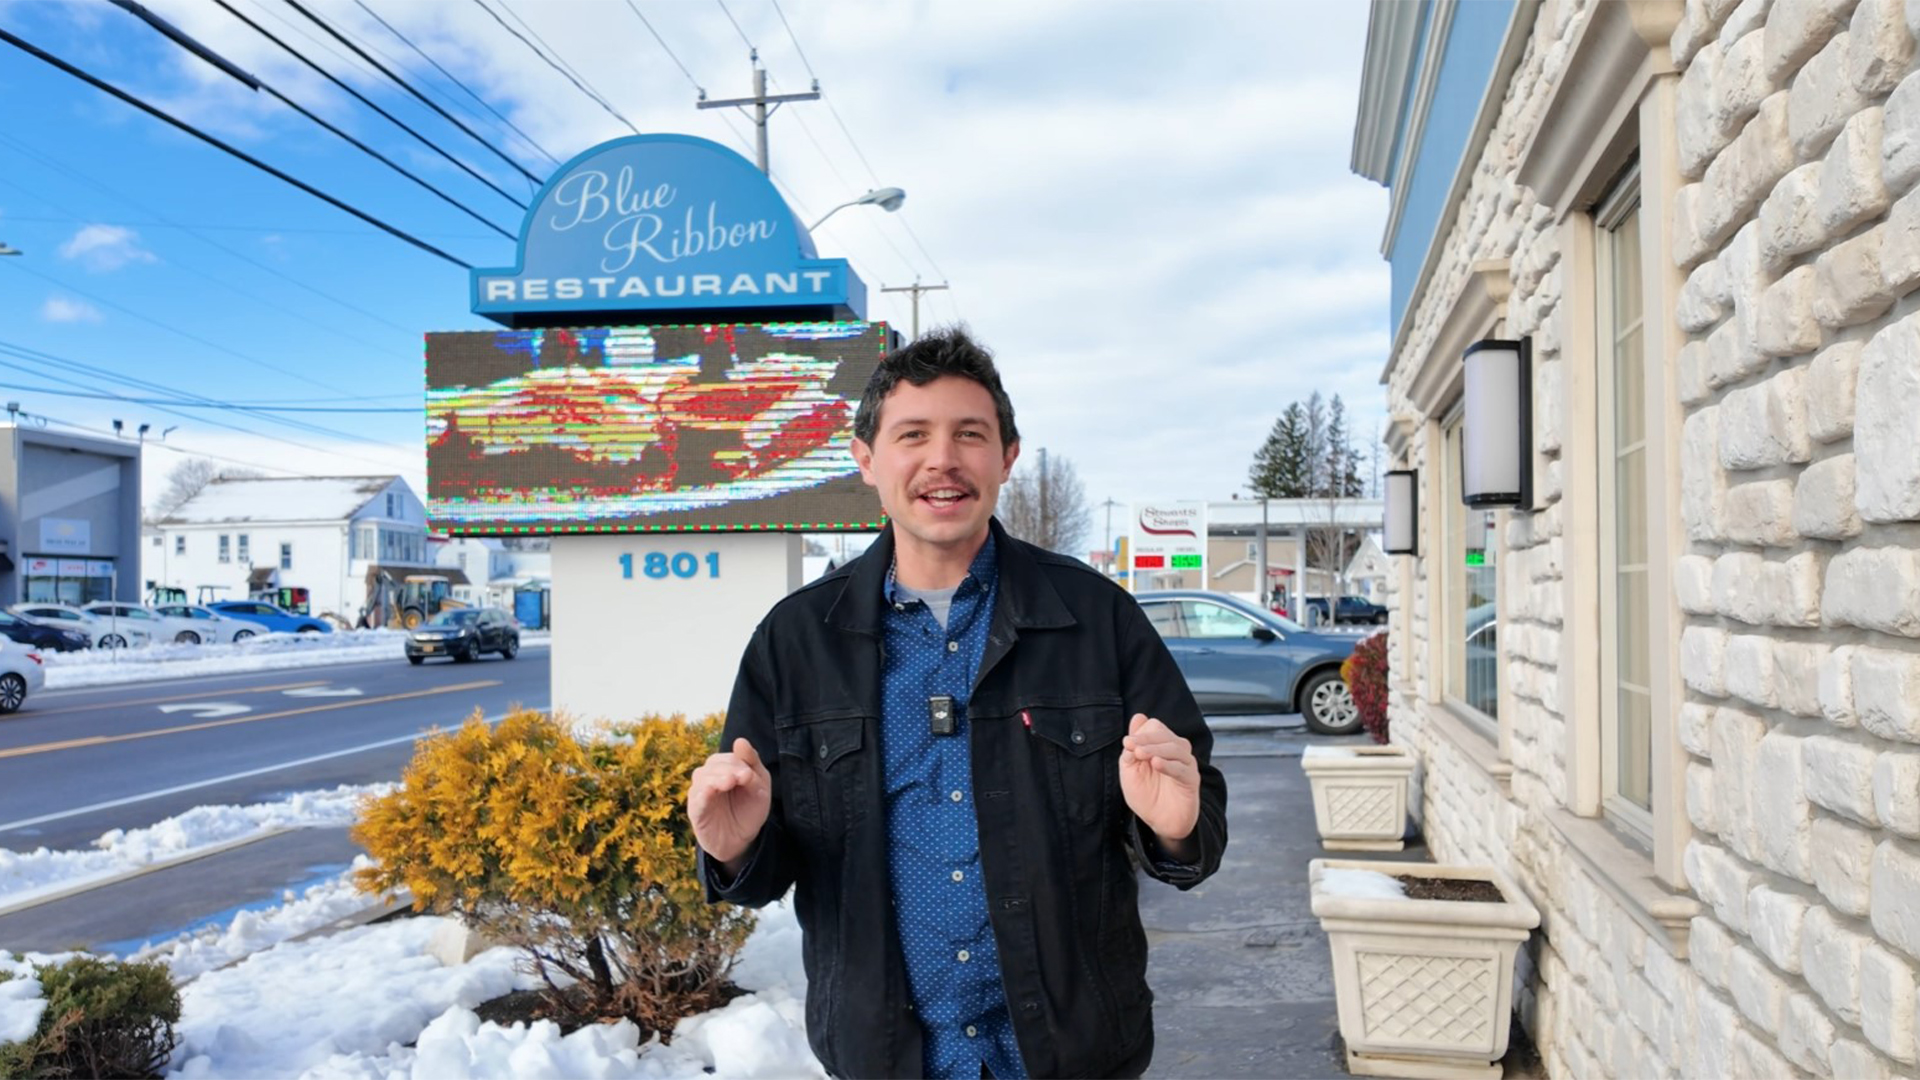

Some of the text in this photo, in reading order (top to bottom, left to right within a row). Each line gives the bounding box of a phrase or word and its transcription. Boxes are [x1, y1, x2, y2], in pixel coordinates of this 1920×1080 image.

[551, 165, 677, 231] Blue
[601, 201, 777, 274] Ribbon
[487, 272, 831, 302] RESTAURANT
[619, 552, 720, 579] 1801
